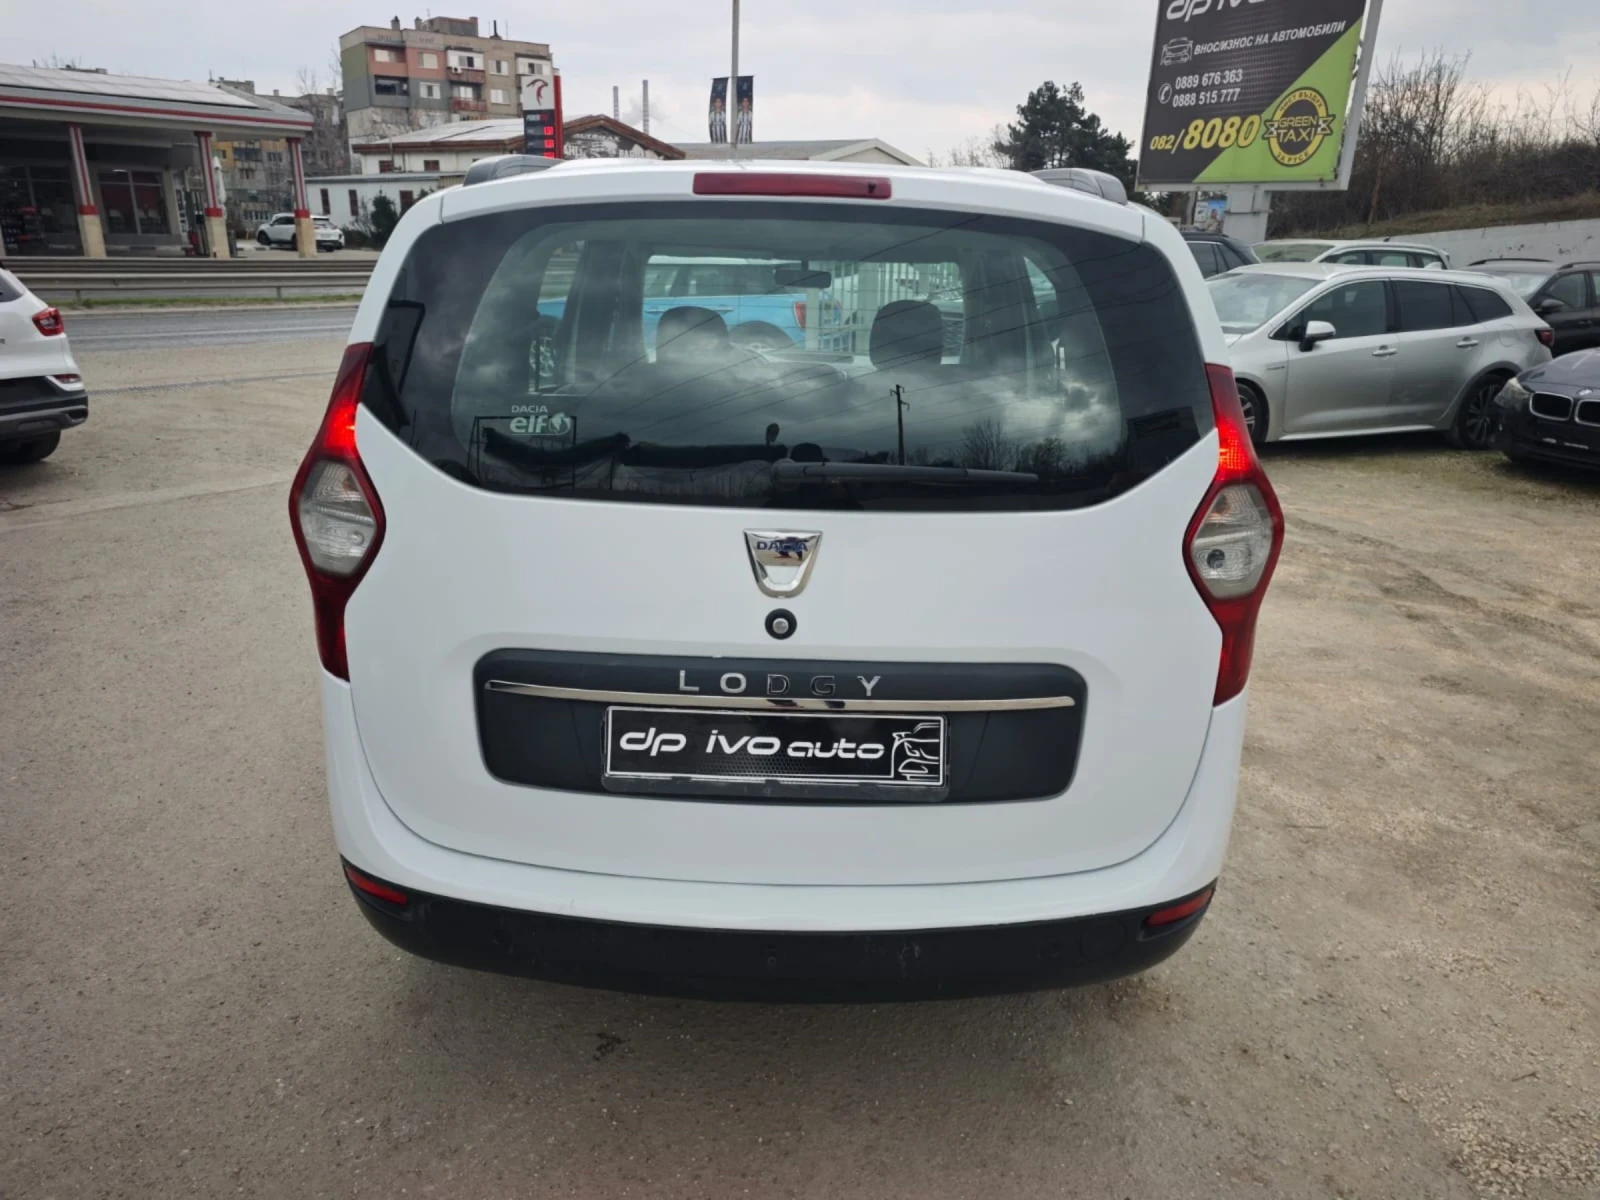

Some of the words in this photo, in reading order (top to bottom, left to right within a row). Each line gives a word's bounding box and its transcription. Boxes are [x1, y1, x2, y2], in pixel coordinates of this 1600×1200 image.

[1254, 33, 1269, 46] НА
[1270, 20, 1347, 43] АВТОМОБИЛИ
[1175, 74, 1200, 90] 0889
[1201, 72, 1221, 87] 676
[1222, 69, 1243, 84] 363
[1172, 92, 1197, 108] 0888
[1198, 90, 1219, 105] 515
[1219, 87, 1241, 103] 777
[1279, 115, 1318, 128] GREEN
[1277, 127, 1316, 143] TAXI
[511, 404, 549, 414] DACIA
[509, 414, 548, 433] elf
[679, 670, 882, 698] LODGY
[619, 727, 687, 757] dp
[705, 729, 781, 757] ivo
[786, 737, 885, 760] auto
